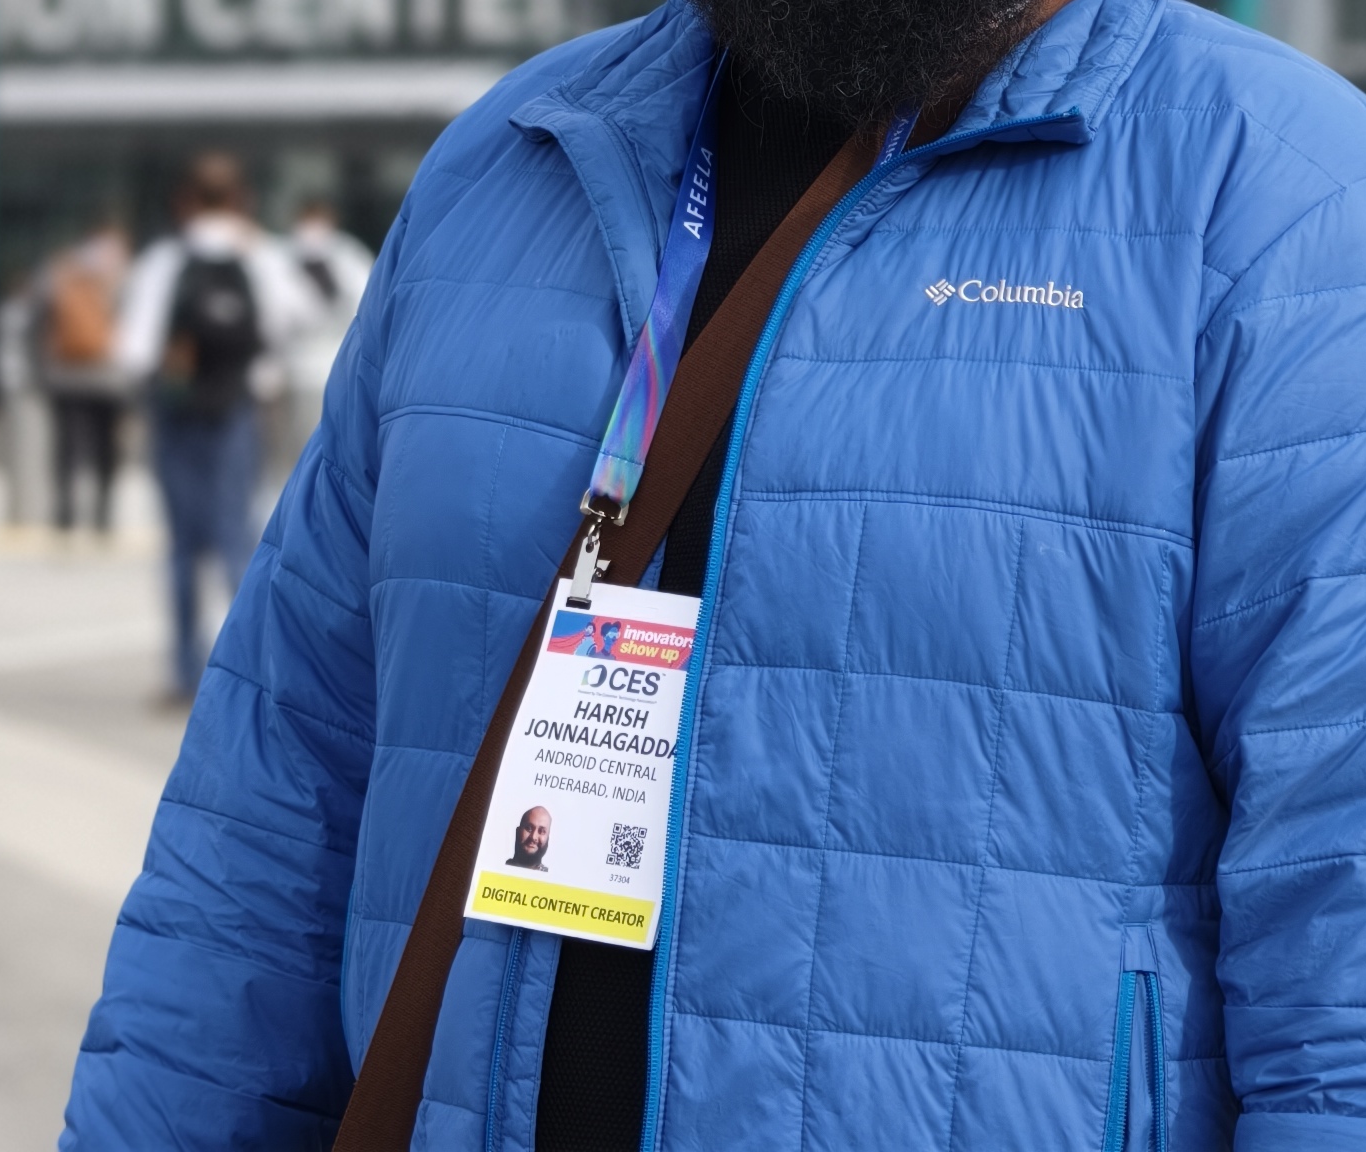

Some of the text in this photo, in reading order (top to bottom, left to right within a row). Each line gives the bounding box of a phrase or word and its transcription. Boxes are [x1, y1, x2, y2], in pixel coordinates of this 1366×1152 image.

[683, 147, 713, 239] AFEELA
[958, 279, 1084, 309] Columbia
[620, 641, 679, 663] show up
[609, 667, 660, 696] CES
[574, 700, 649, 729] HARISH
[525, 718, 678, 759] JONNALAGADDA
[535, 748, 657, 781] ANDROID CENTRAL
[534, 773, 646, 804] HYDERABAD, INDIA
[609, 873, 631, 884] 37304
[481, 886, 645, 928] DIGITAL CONTENT CREATOR
